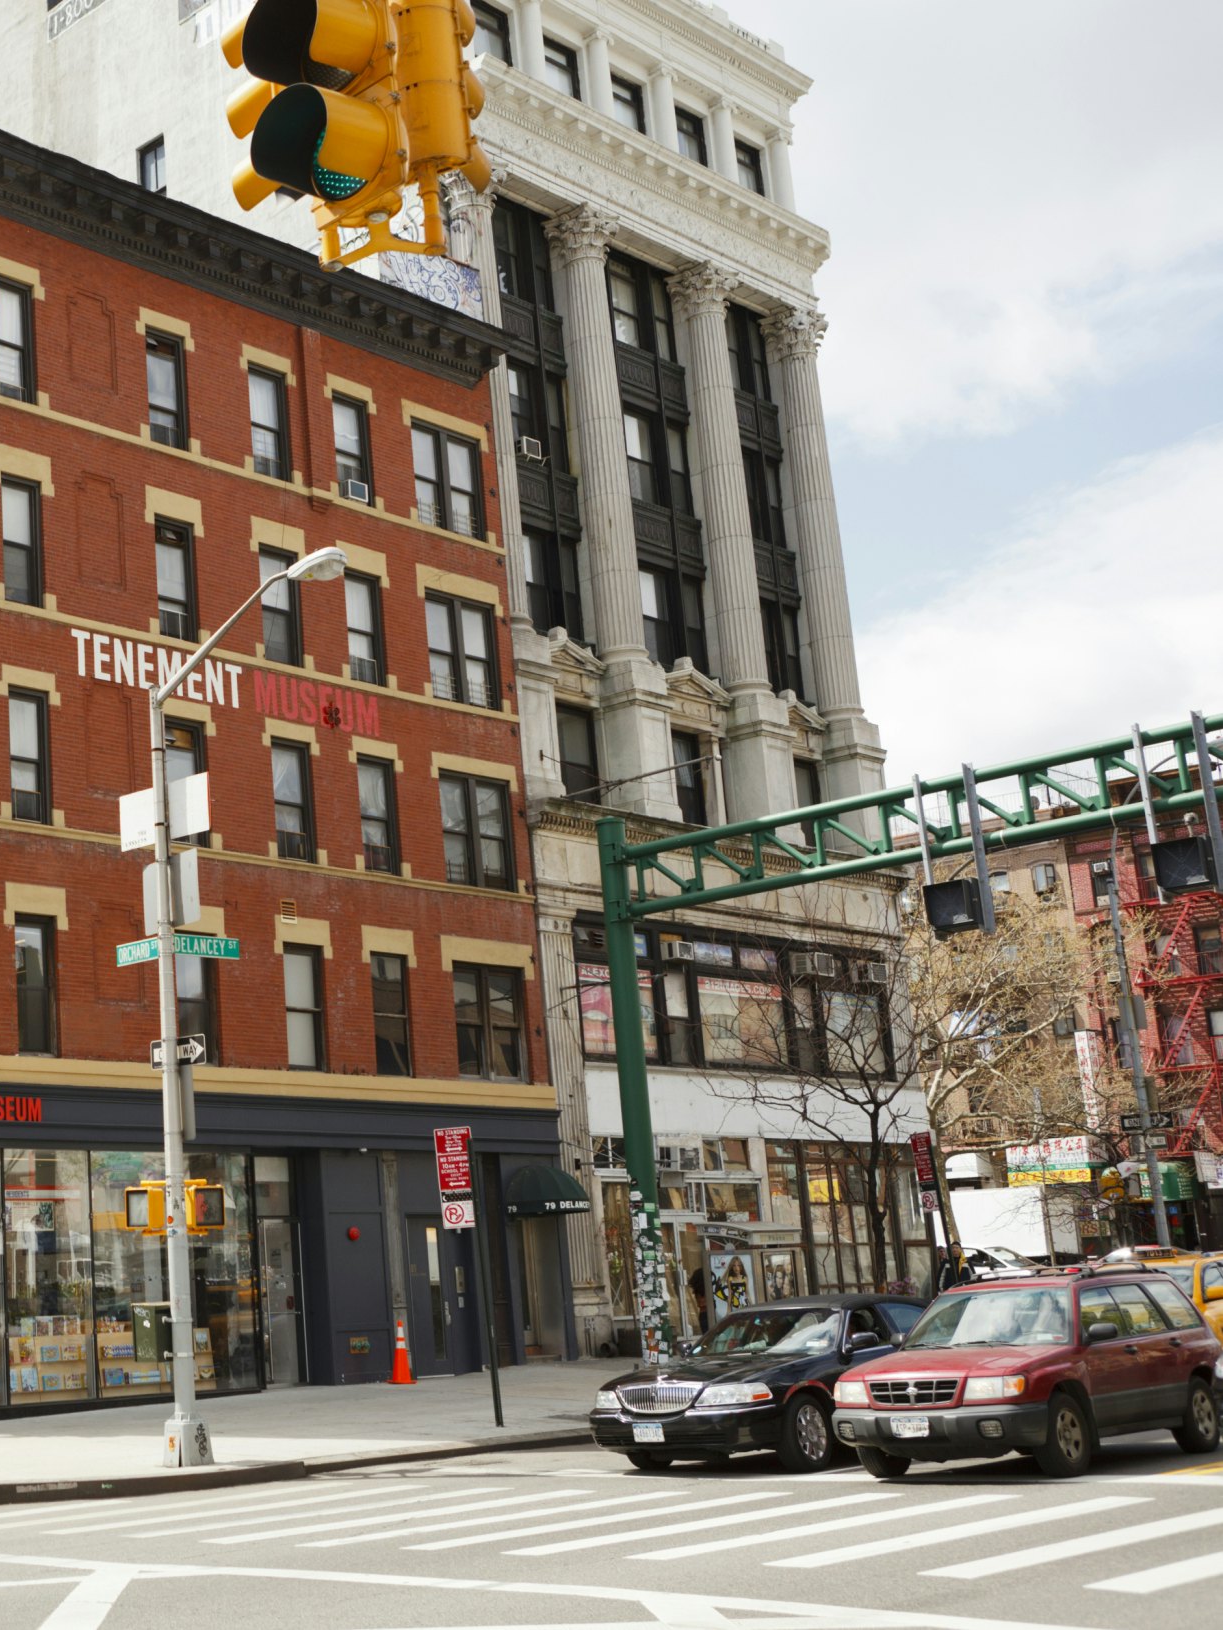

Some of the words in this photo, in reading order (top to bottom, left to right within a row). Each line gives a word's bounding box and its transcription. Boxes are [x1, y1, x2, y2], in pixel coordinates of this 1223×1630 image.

[71, 628, 242, 709] TENEMENT
[254, 669, 381, 736] MUSEUM
[118, 942, 150, 964] ORCHARD
[175, 937, 226, 956] DELANCEY
[228, 941, 237, 949] ST
[182, 1045, 197, 1057] WAY
[545, 1202, 556, 1210] 79
